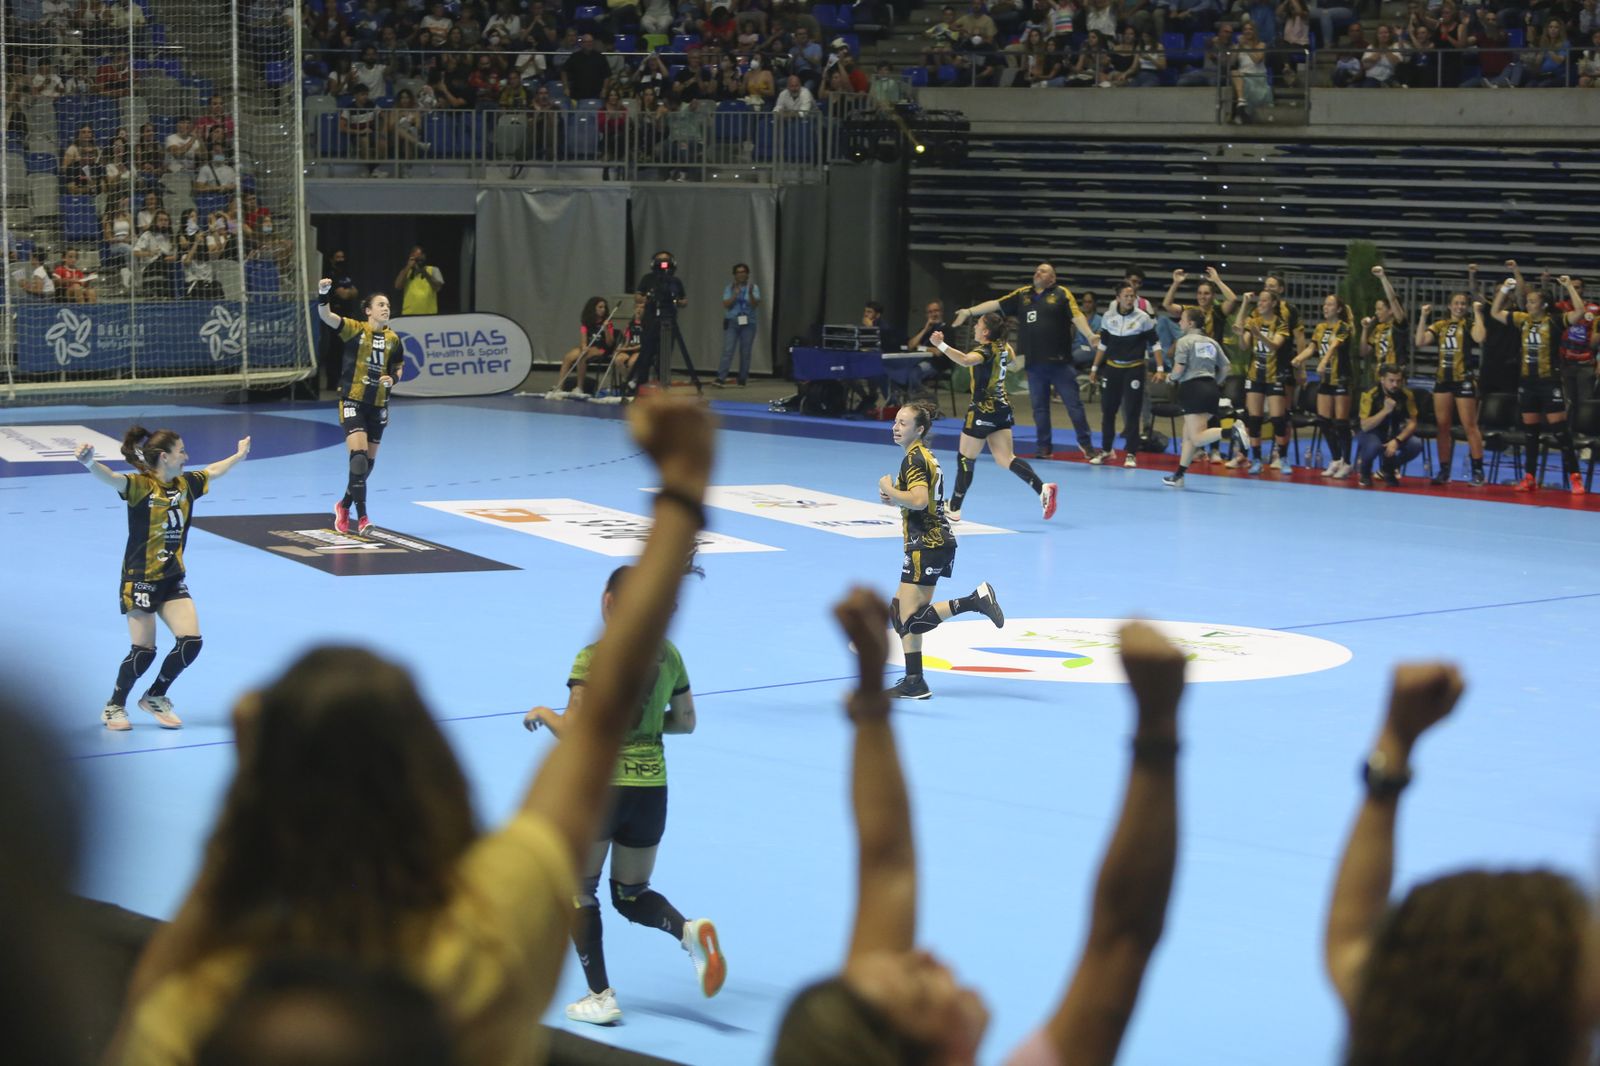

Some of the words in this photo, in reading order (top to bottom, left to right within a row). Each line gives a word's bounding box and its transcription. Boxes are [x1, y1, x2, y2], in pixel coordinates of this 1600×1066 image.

[424, 330, 507, 348] FIDIAS
[427, 348, 464, 359] Health
[467, 348, 475, 357] &
[479, 347, 508, 359] Sport
[429, 357, 512, 376] center
